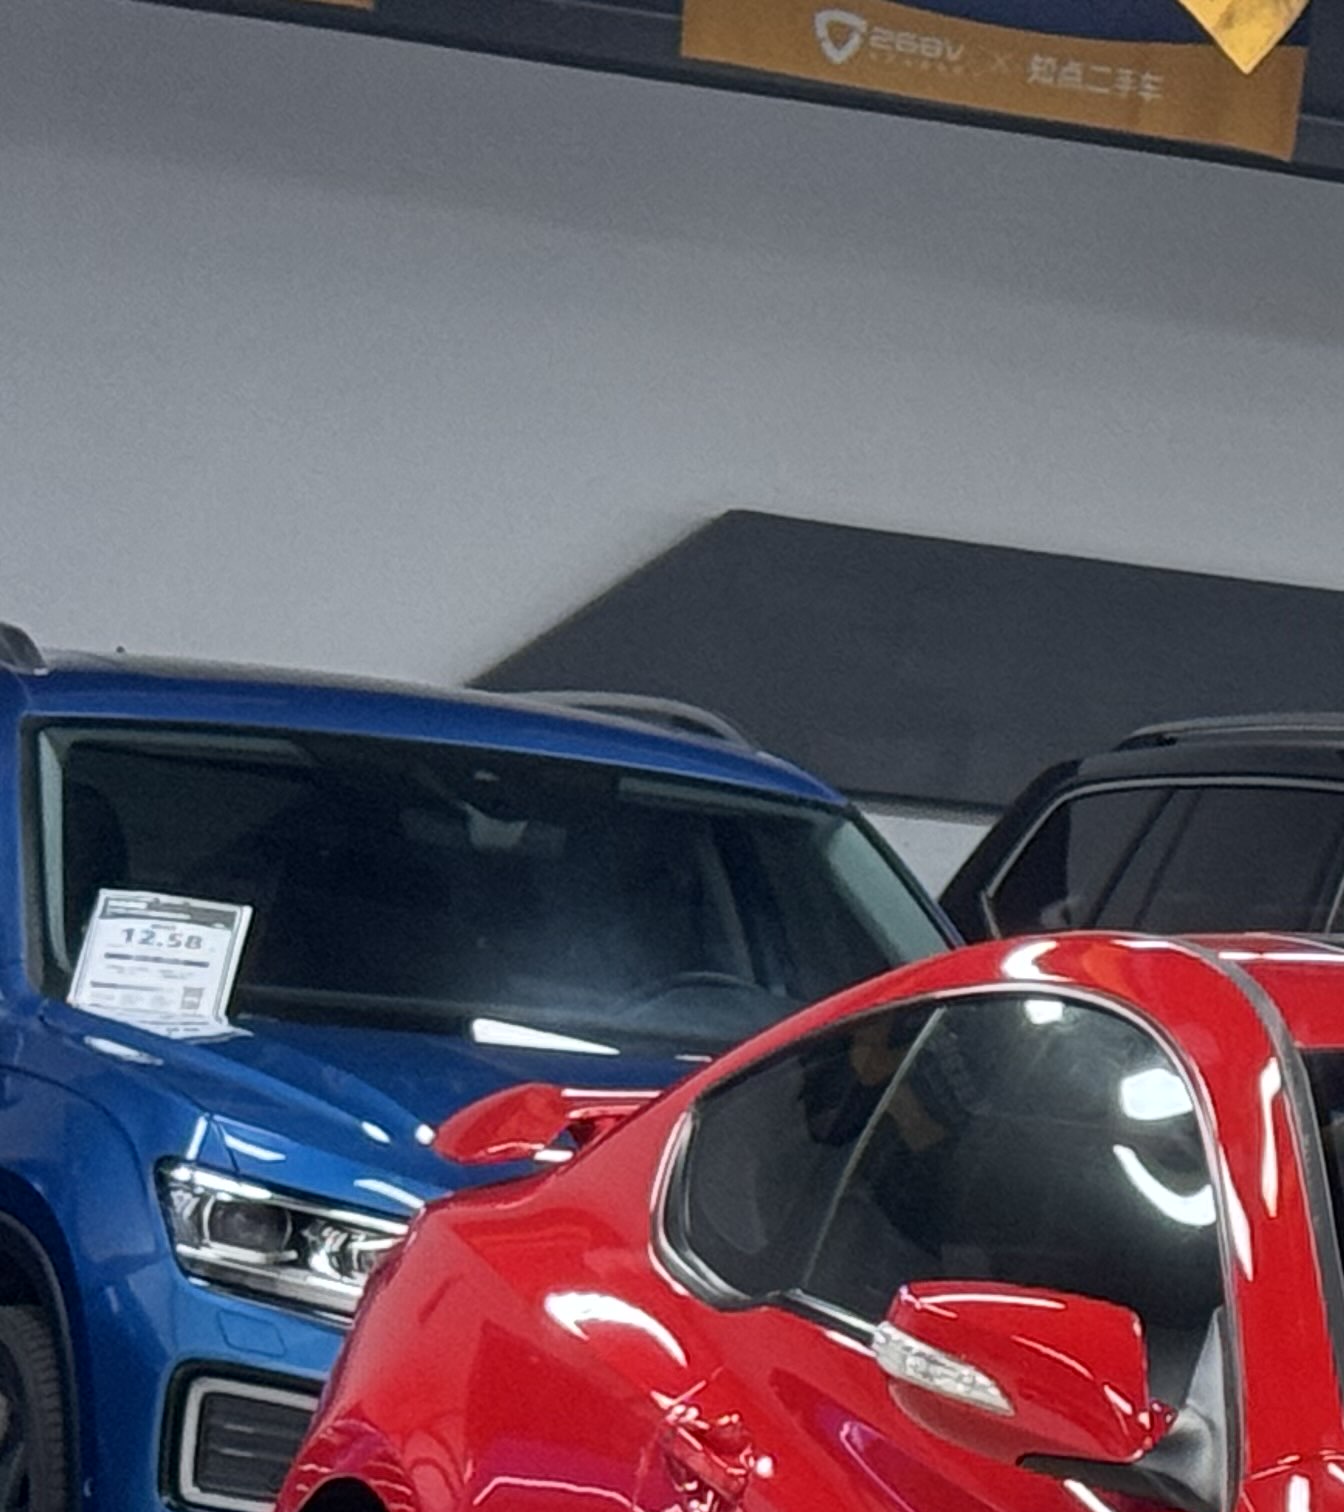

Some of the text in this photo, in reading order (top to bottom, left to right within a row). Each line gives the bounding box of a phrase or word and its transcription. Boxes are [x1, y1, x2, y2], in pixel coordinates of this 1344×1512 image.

[868, 26, 1165, 102] 268V 知点二手车
